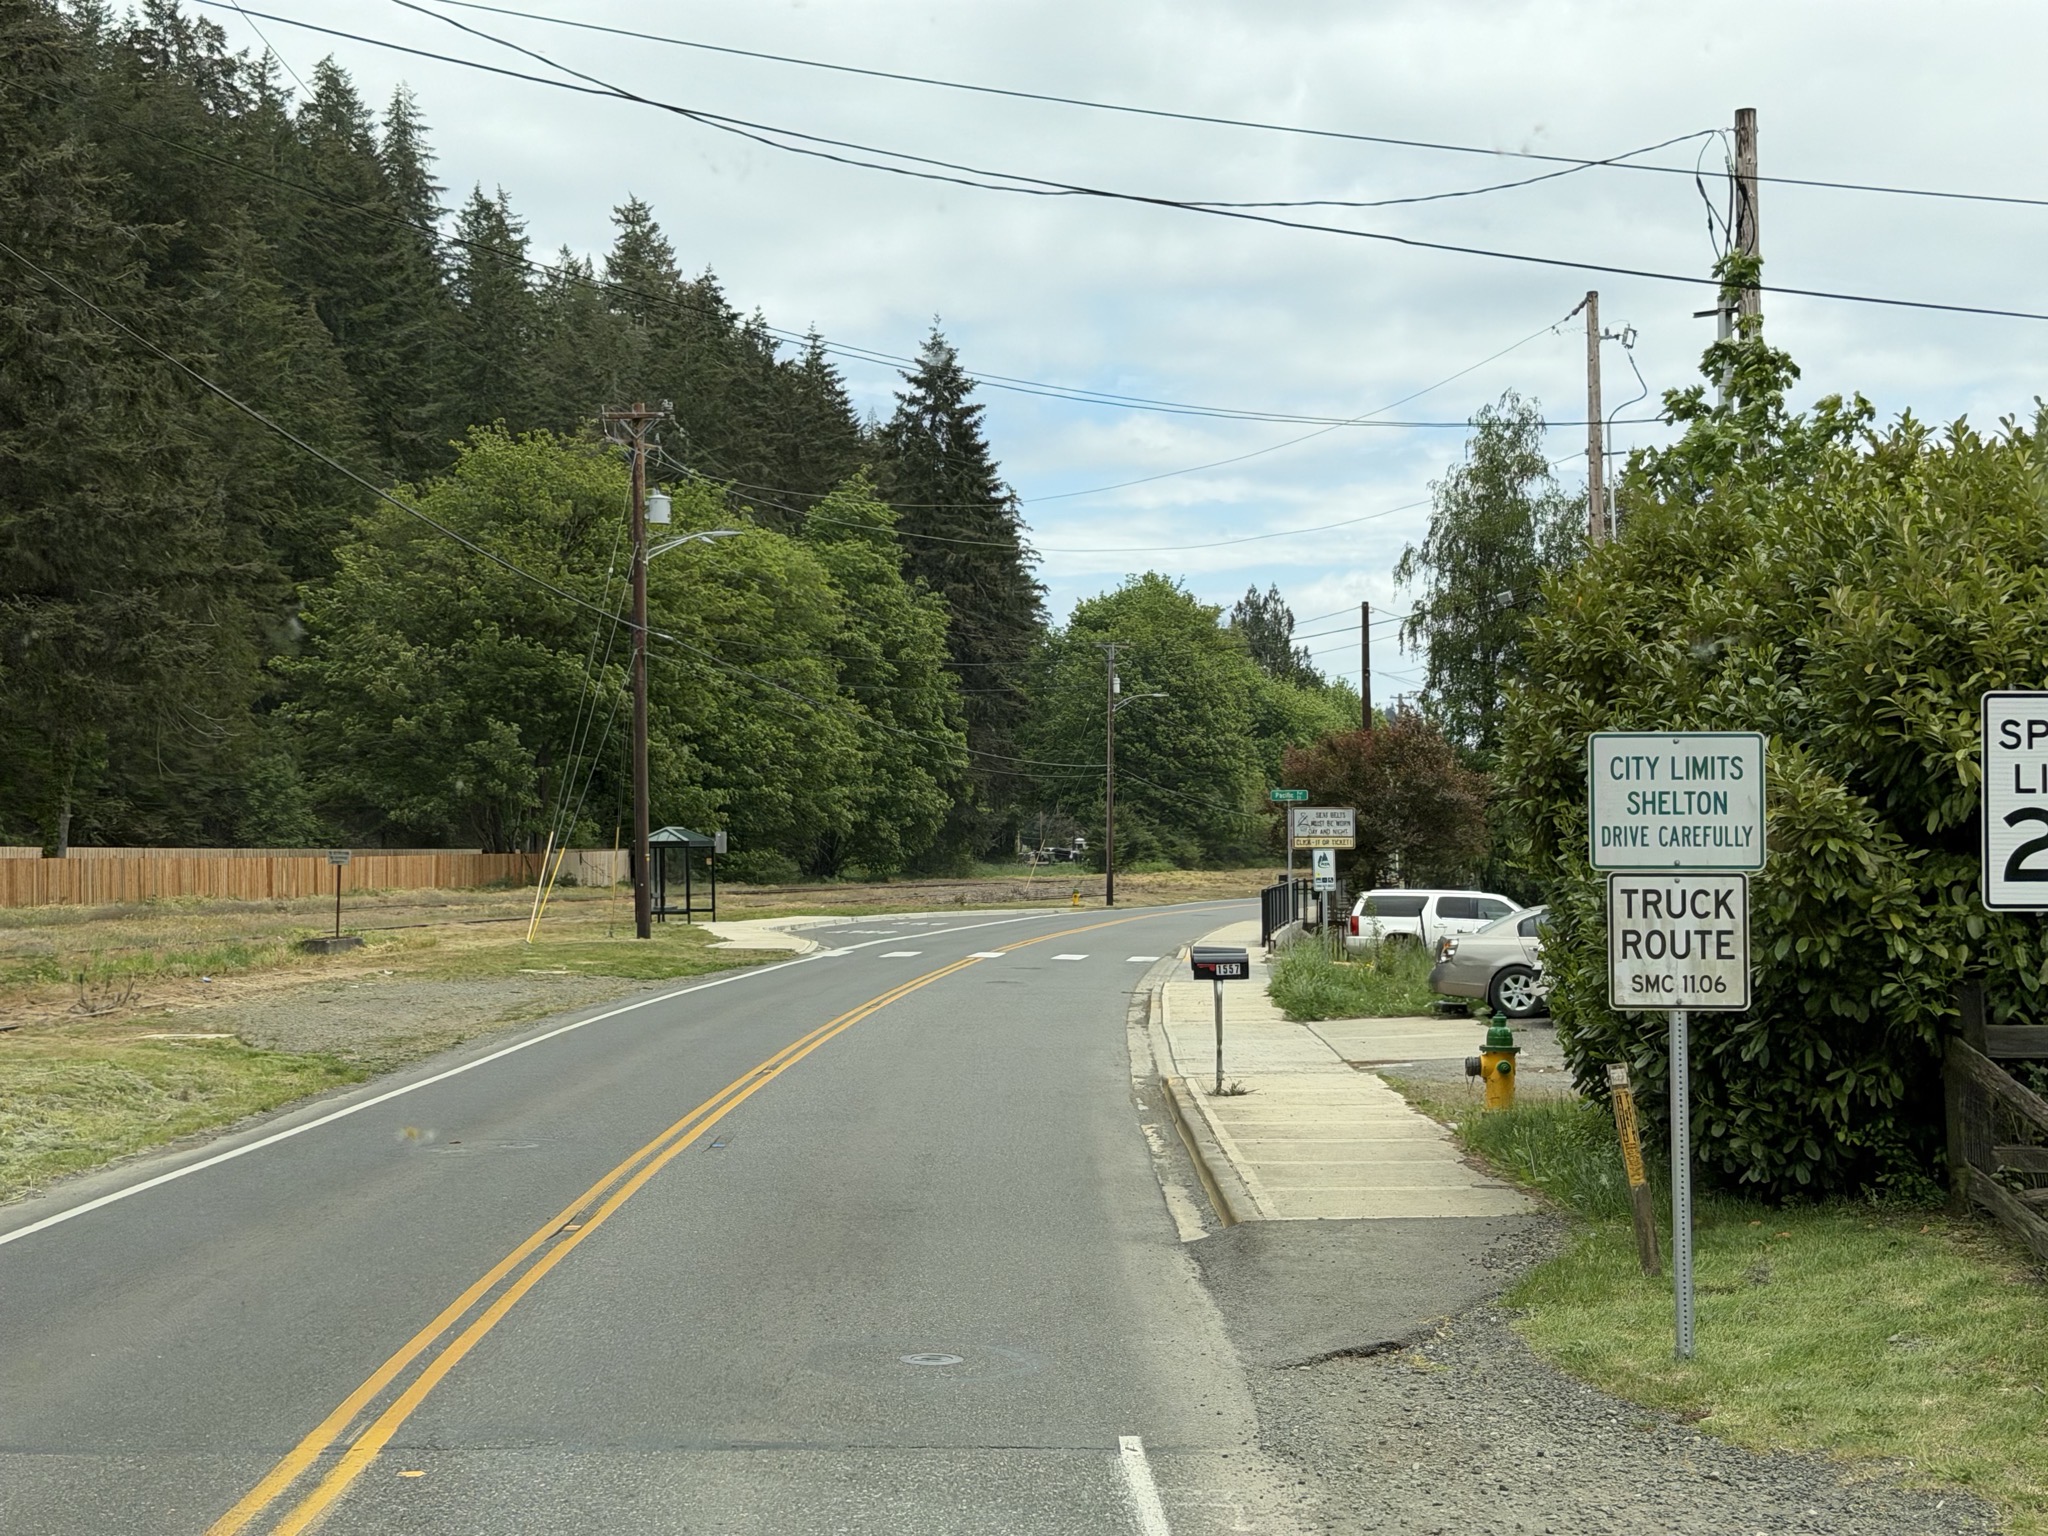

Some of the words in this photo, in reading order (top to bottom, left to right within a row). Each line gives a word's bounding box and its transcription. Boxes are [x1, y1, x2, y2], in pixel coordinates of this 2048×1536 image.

[1610, 756, 1659, 780] CITY
[1671, 756, 1744, 780] LIMITS
[1627, 791, 1728, 815] SHELTON
[1601, 826, 1649, 847] DRIVE
[1658, 826, 1753, 847] CAREFULLY
[1620, 889, 1736, 919] TRUCK
[1621, 929, 1736, 960] ROUTE
[1217, 964, 1240, 975] 1557
[1631, 974, 1675, 993] SMC
[1682, 974, 1727, 993] 11.06
